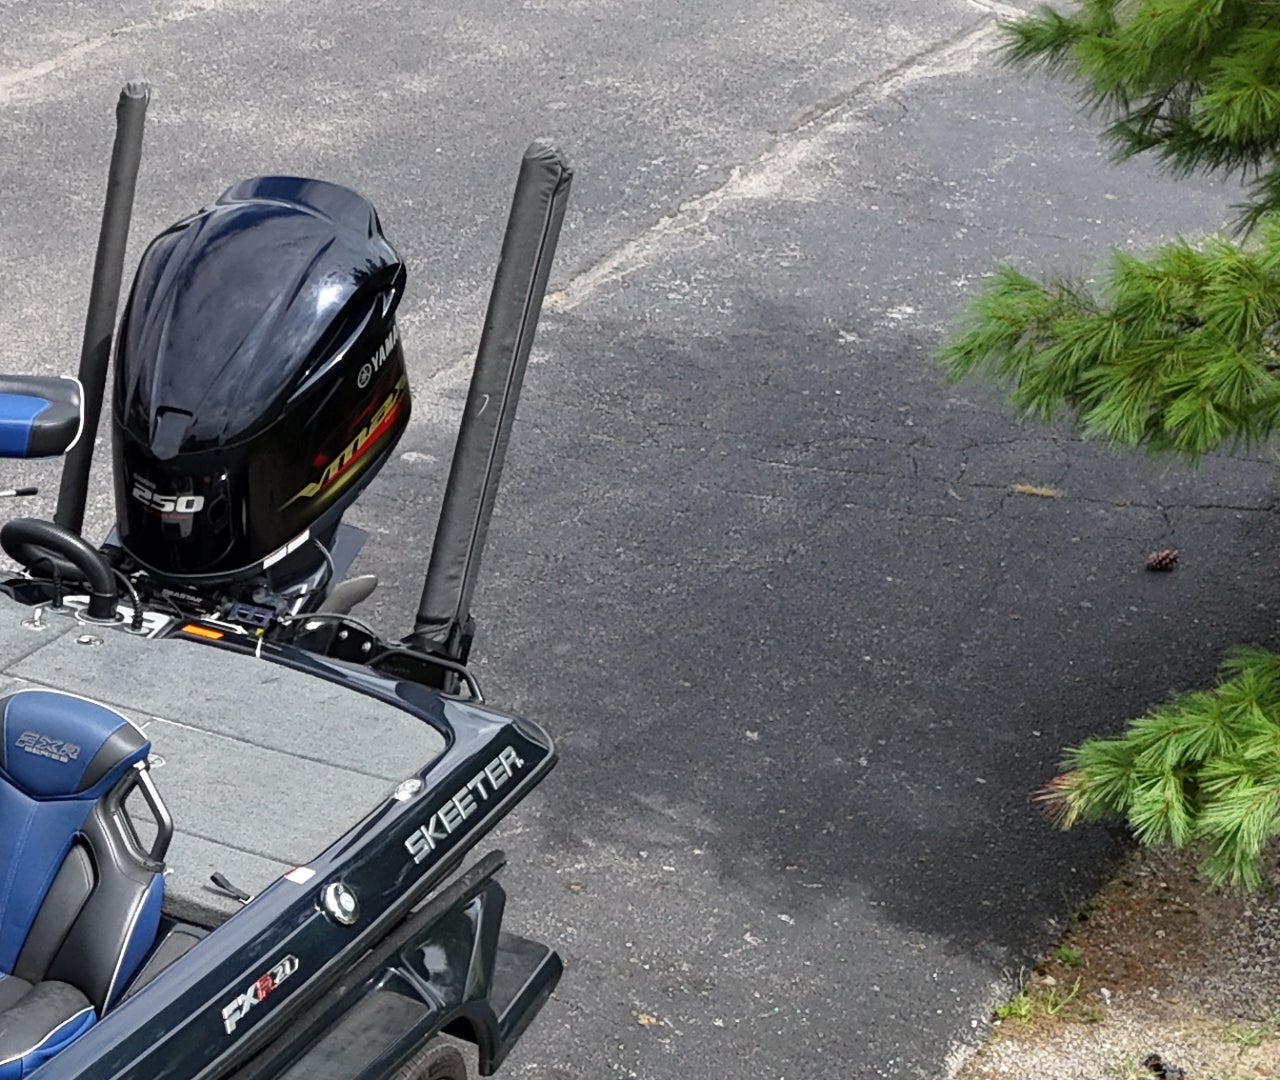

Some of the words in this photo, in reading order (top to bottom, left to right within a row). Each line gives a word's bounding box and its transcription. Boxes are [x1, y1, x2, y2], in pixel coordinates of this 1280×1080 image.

[371, 324, 399, 373] YAMA
[132, 481, 205, 513] 250
[15, 731, 80, 760] FXR
[403, 745, 523, 865] SKEETER
